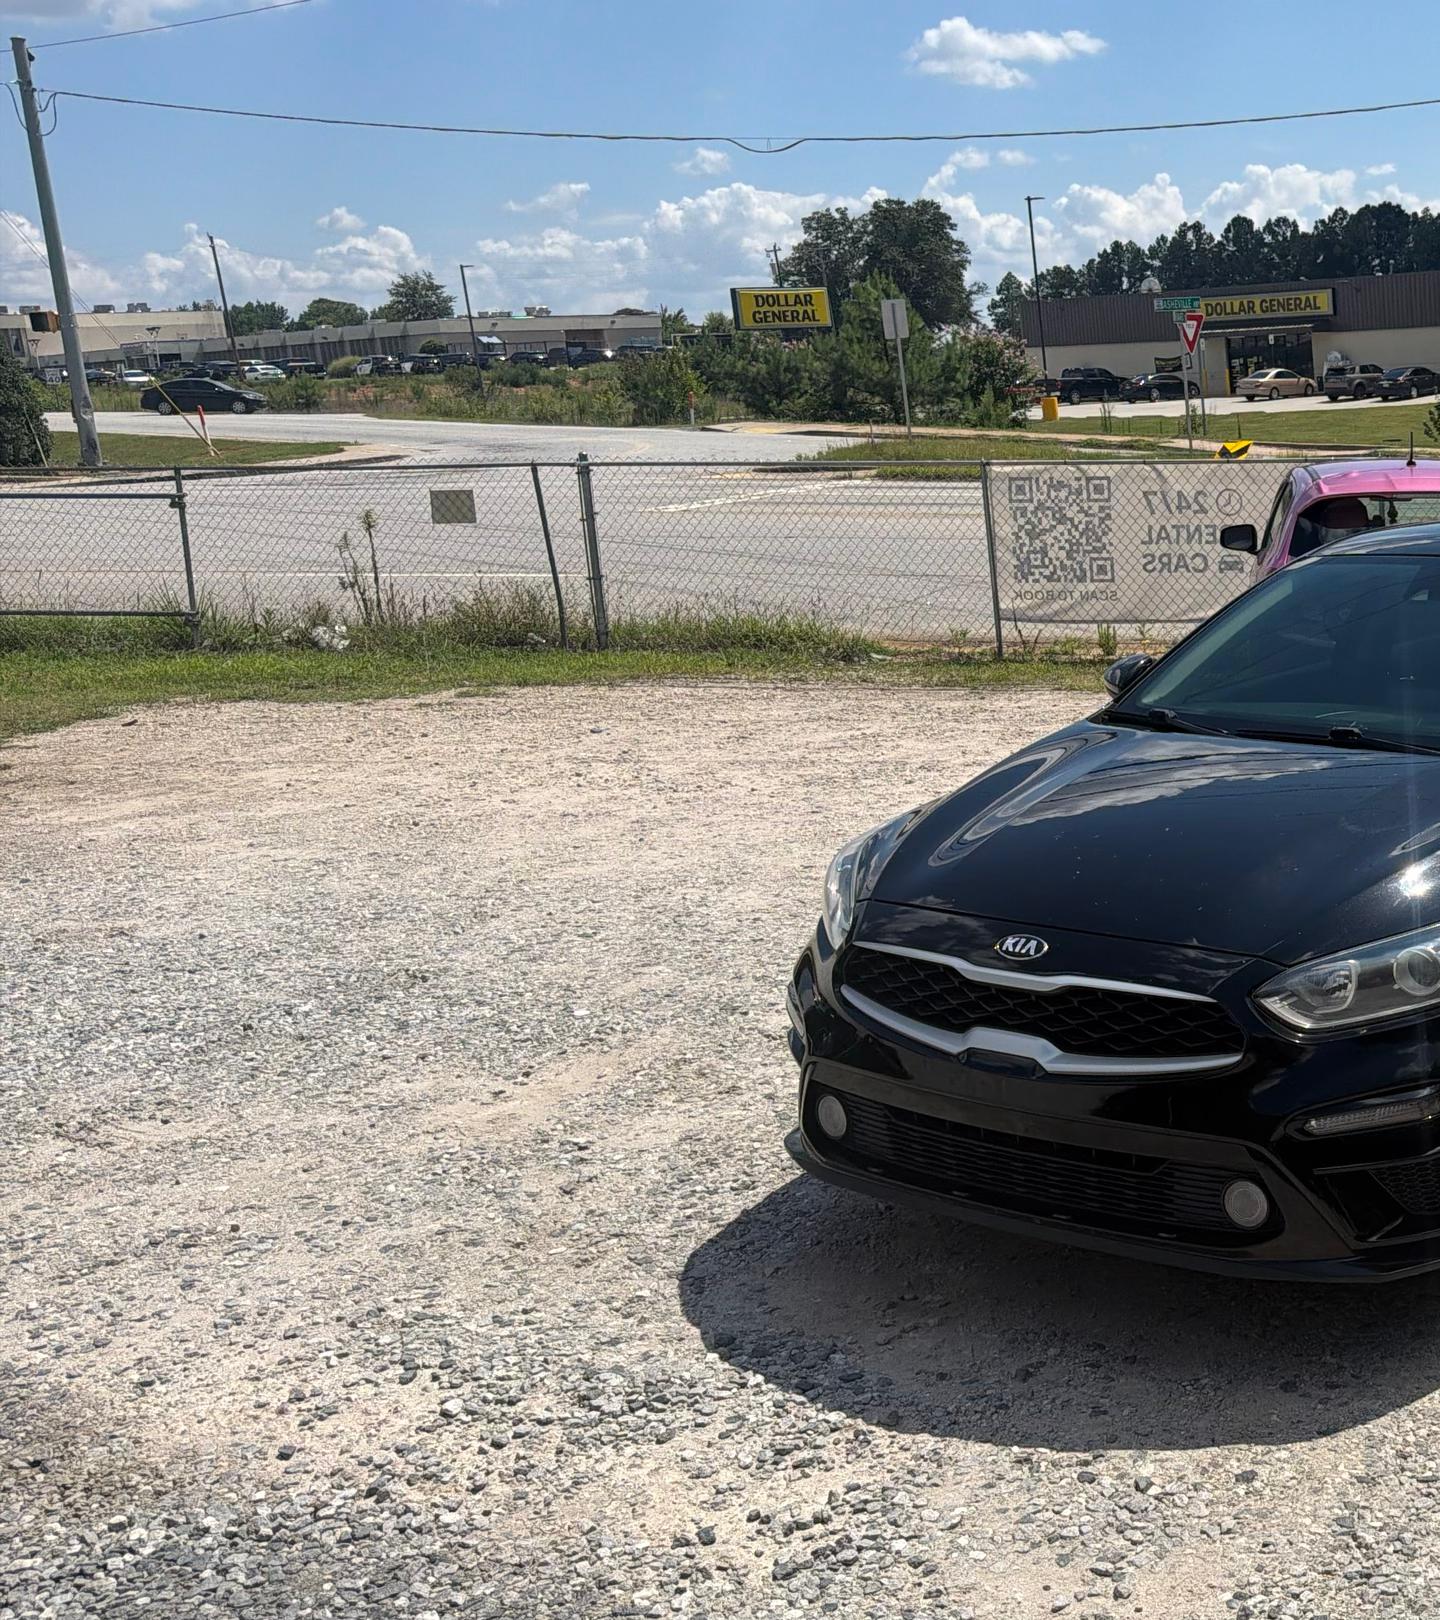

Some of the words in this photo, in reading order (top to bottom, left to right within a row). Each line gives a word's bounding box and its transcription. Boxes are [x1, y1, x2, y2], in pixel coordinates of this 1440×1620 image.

[753, 293, 814, 307] DOLLAR
[1163, 299, 1192, 309] ASHEVILLE
[1204, 299, 1256, 317] DOLLAR
[1259, 295, 1321, 314] GENERAL
[752, 309, 820, 323] GENERAL
[1002, 936, 1037, 956] KIA
